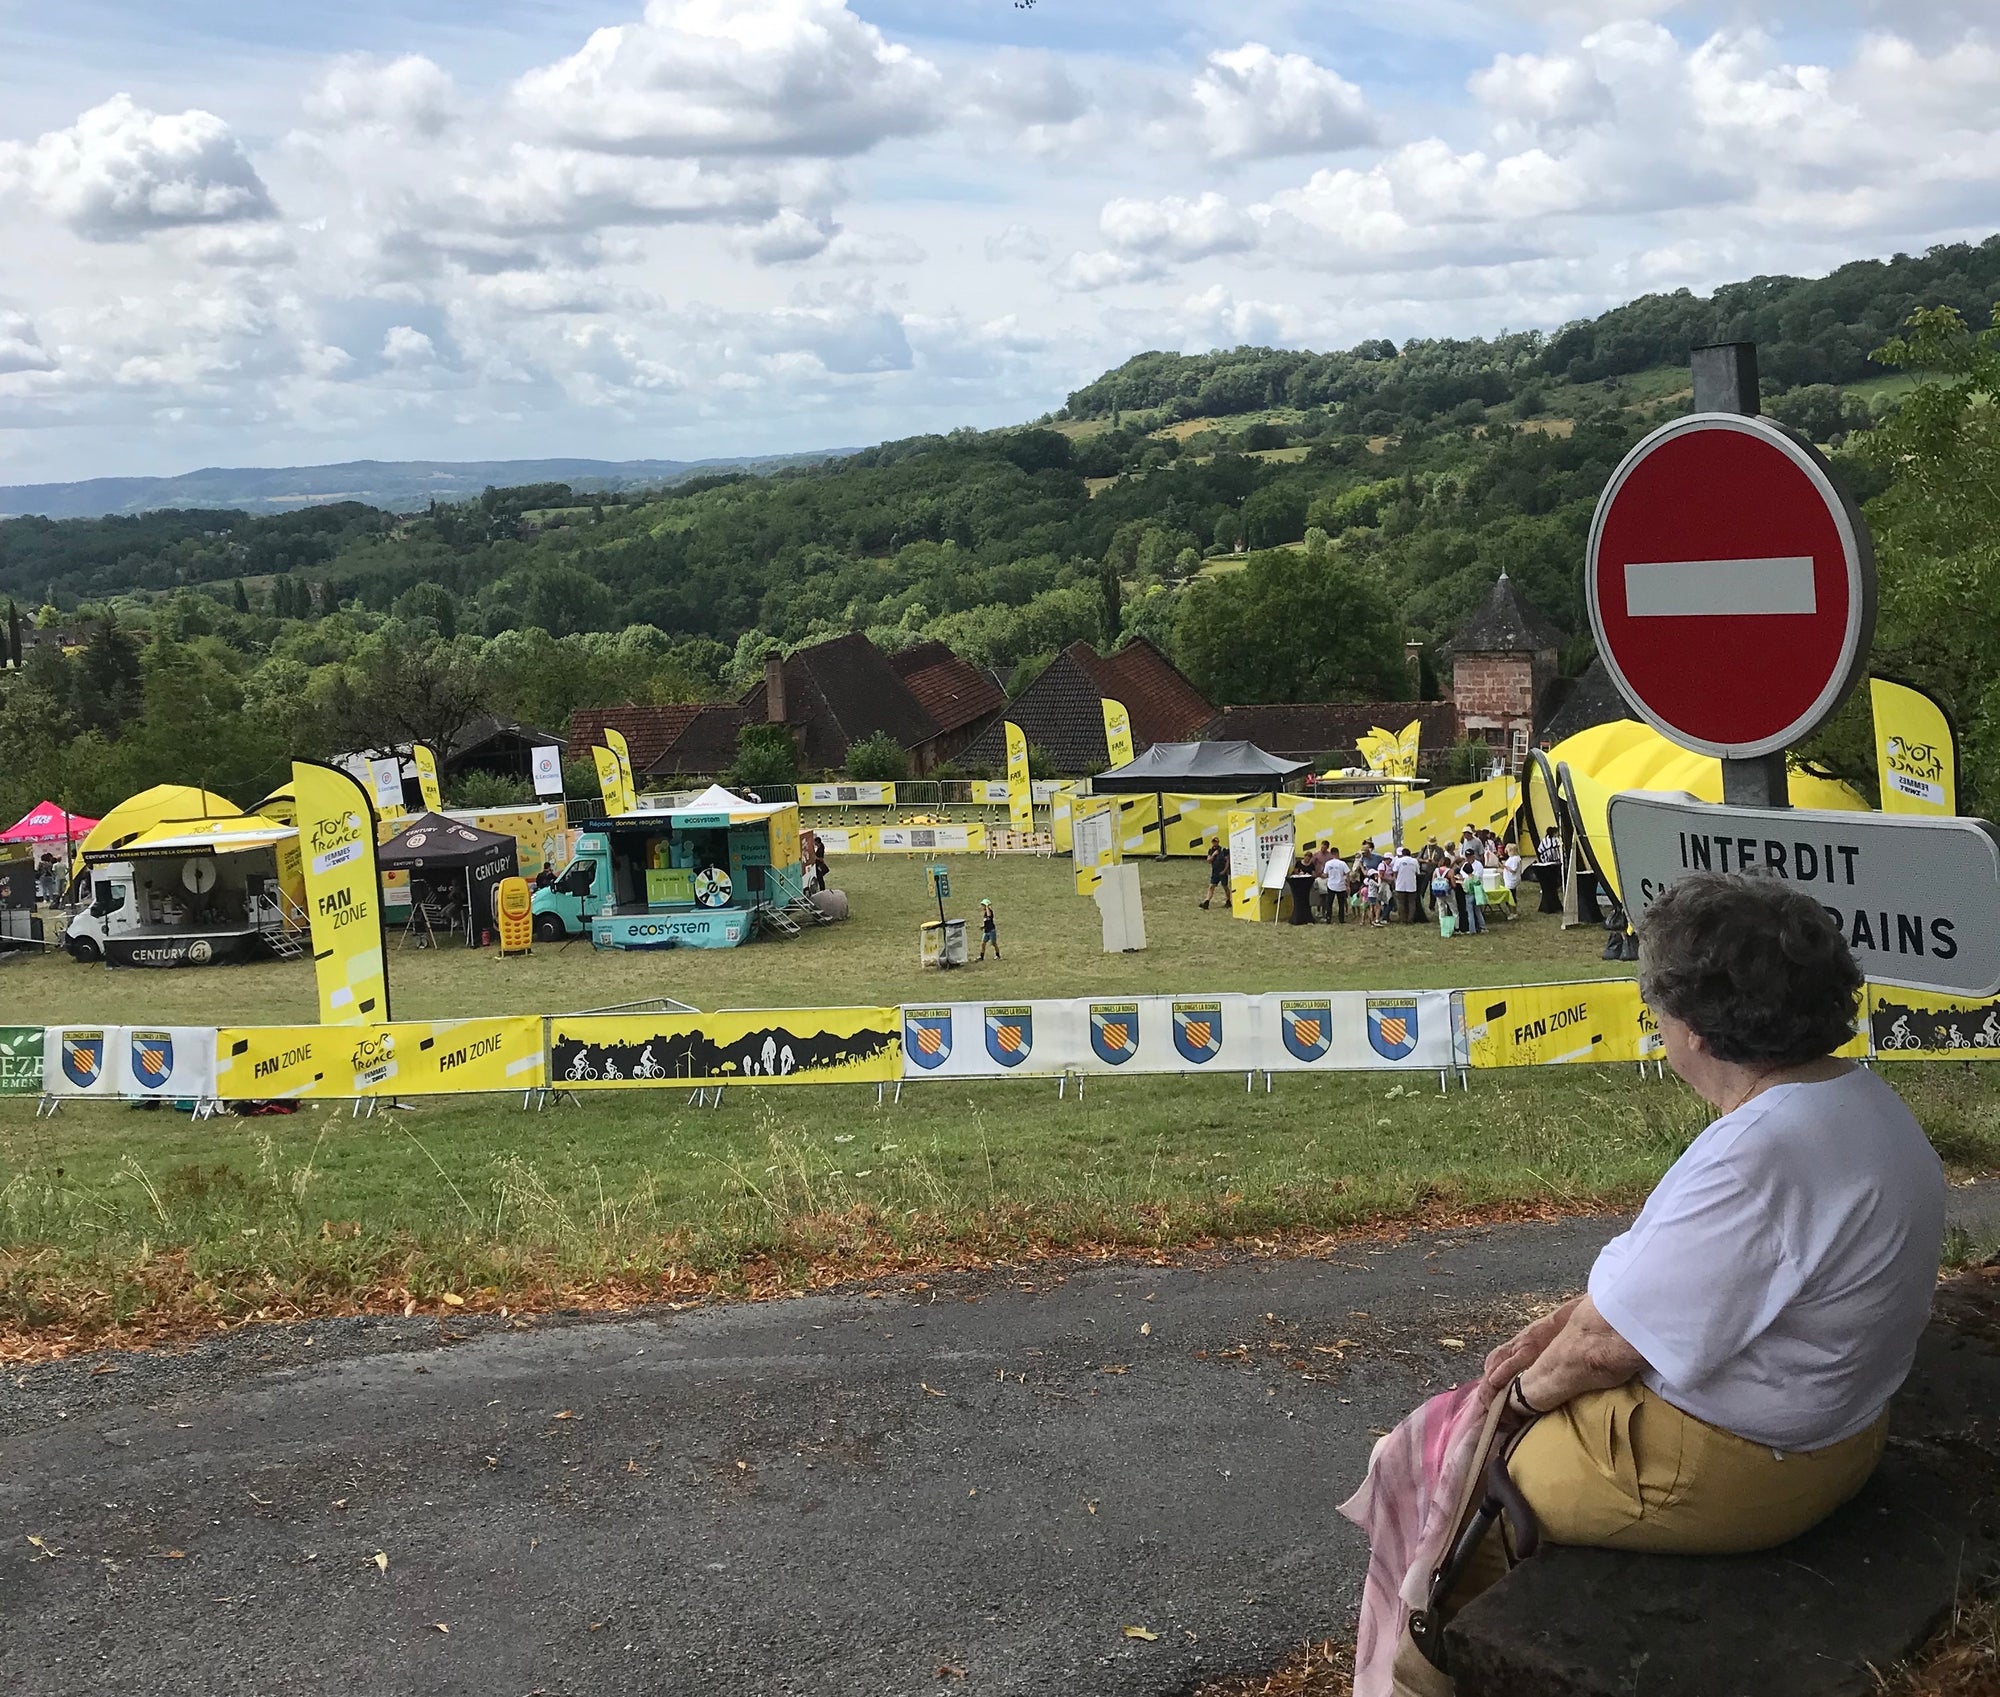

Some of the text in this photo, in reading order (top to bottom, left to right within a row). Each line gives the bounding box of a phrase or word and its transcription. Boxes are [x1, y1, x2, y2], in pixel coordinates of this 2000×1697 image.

[405, 827, 438, 837] CENTURY
[684, 816, 720, 825] ecosystem
[475, 856, 511, 881] CENTURY
[1680, 832, 1859, 885] INTERDIT
[318, 887, 351, 916] FAN
[333, 902, 367, 930] ZONE
[628, 922, 710, 936] ecosystem
[132, 948, 186, 960] CENTURY
[1515, 1003, 1587, 1045] FAN ZONE
[254, 1043, 312, 1079] FAN ZONE
[440, 1033, 502, 1073] FAN ZONE
[2, 1078, 42, 1088] EMEN
